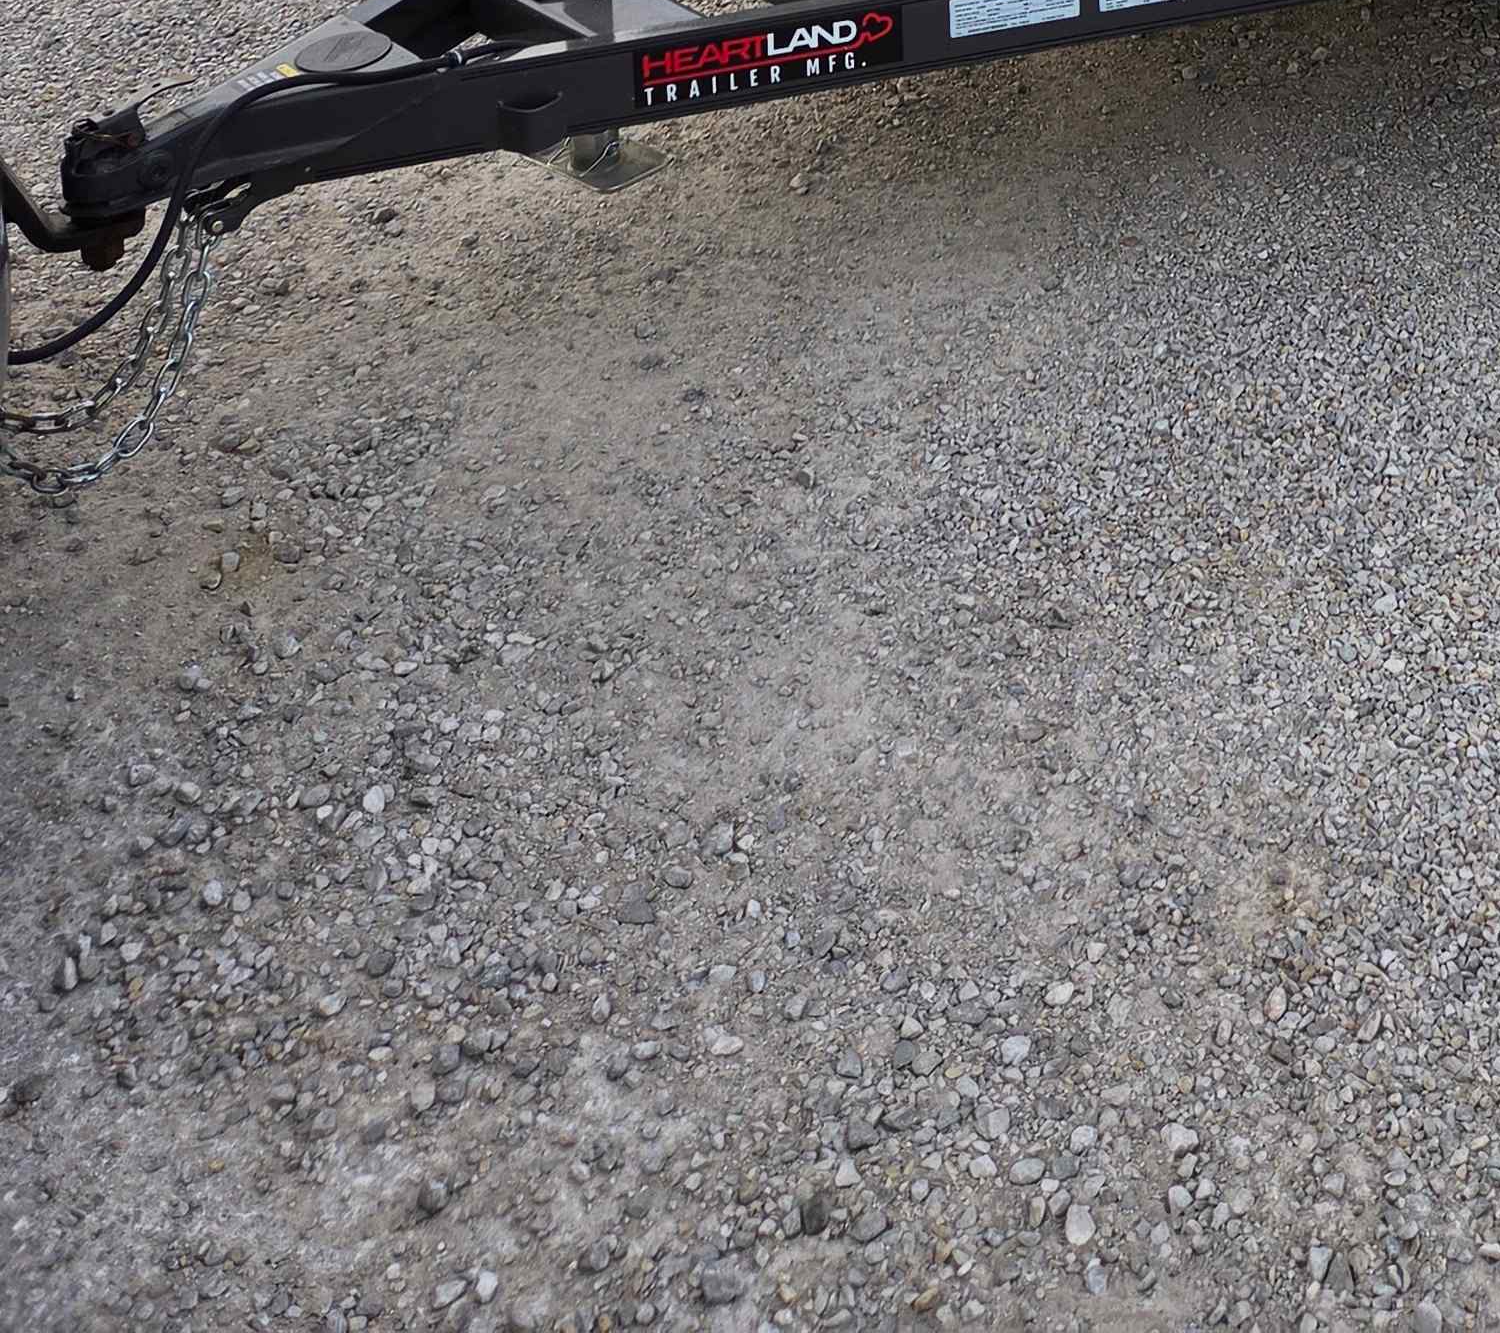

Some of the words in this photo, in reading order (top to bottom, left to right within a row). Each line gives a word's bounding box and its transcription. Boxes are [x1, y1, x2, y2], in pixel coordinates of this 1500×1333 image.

[641, 19, 858, 80] HEARTLAND
[644, 65, 782, 107] TRAILER
[806, 51, 867, 78] MFG.
